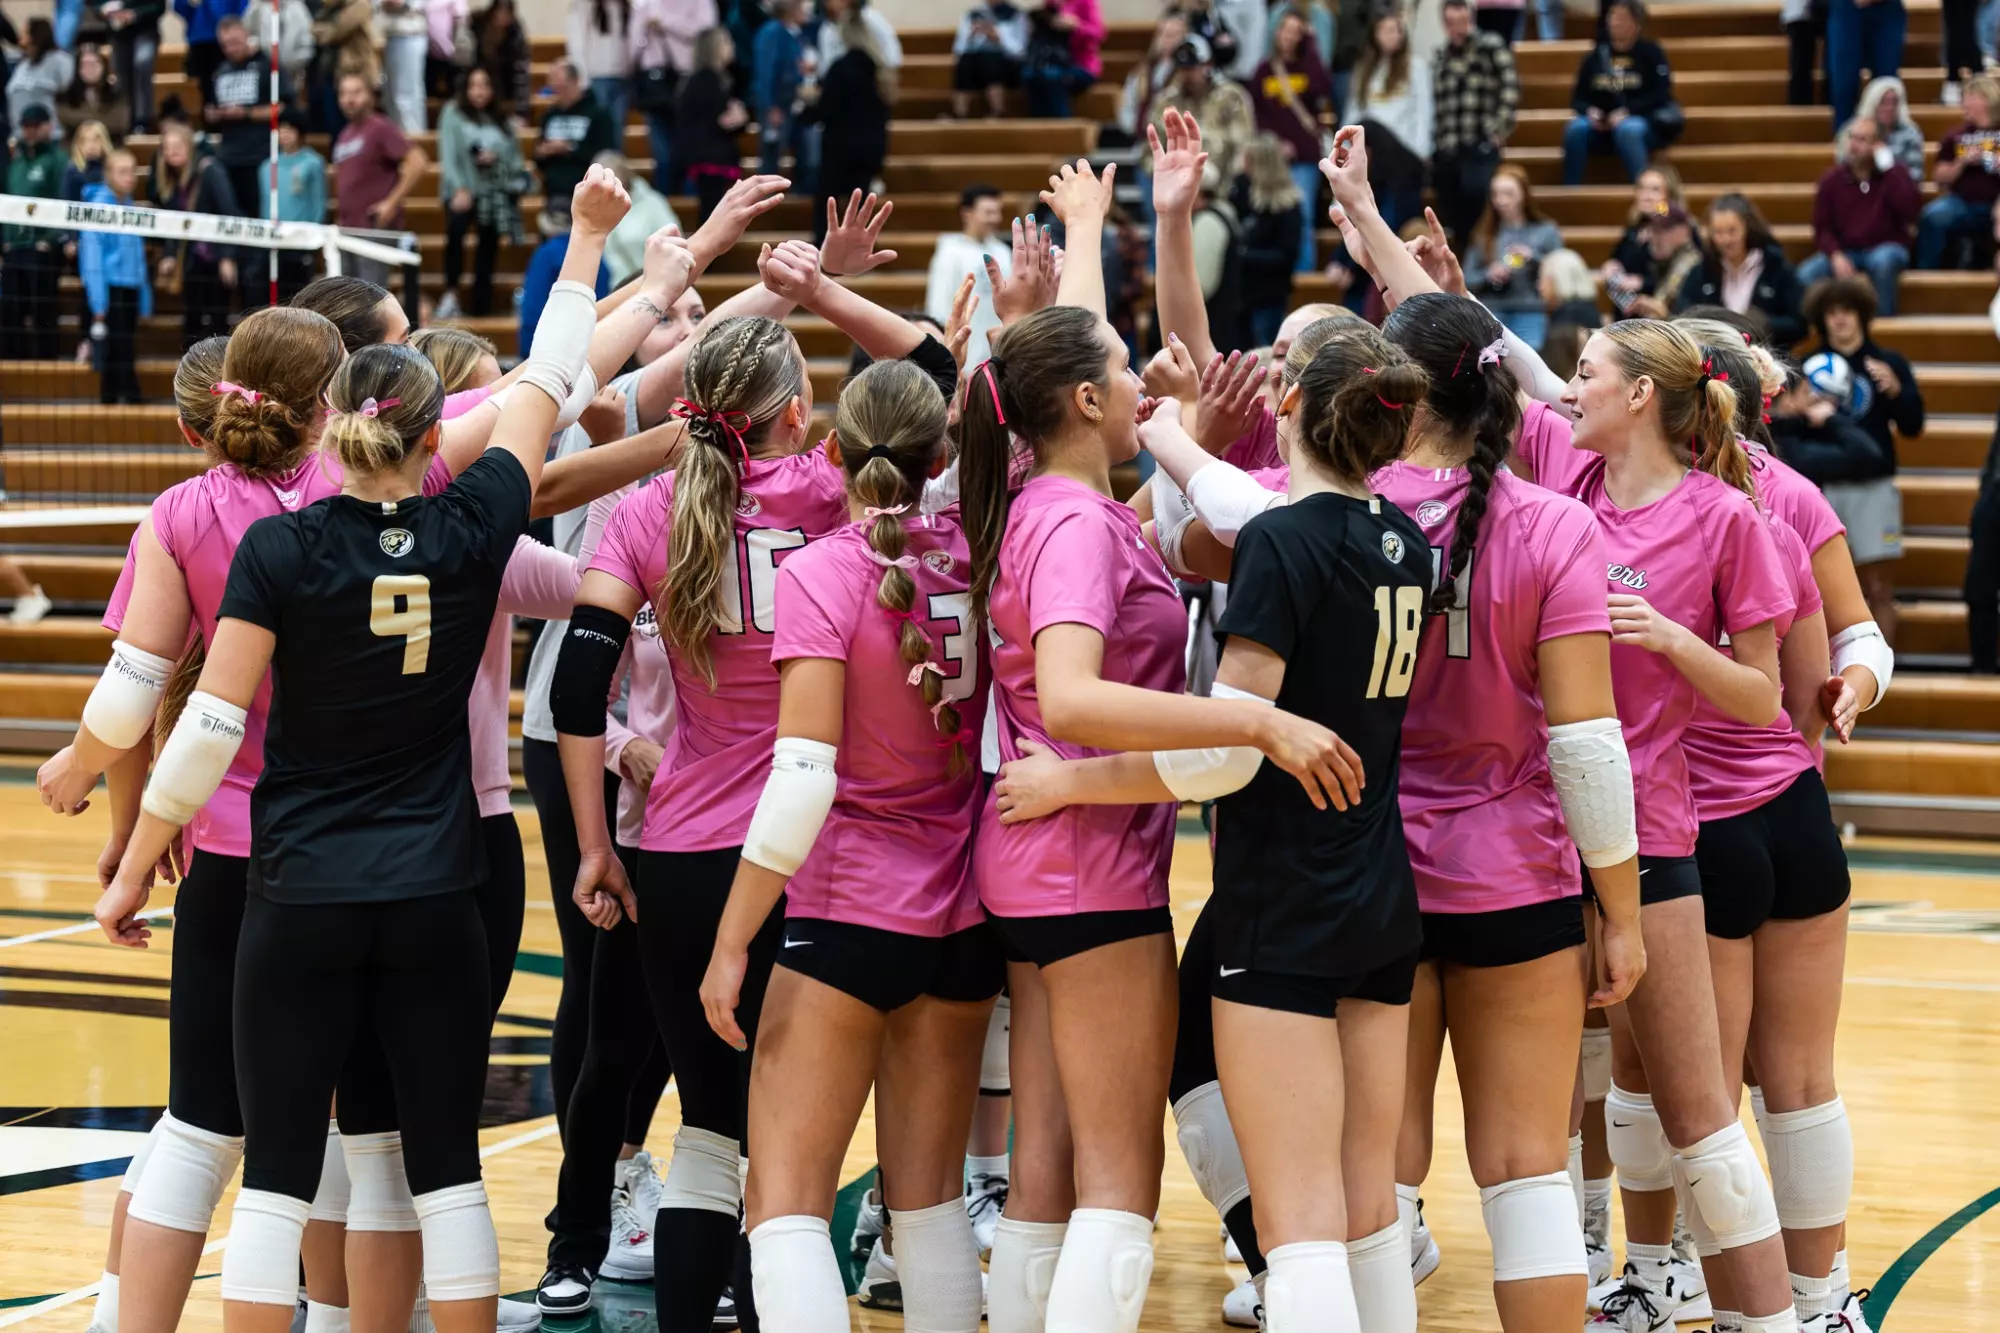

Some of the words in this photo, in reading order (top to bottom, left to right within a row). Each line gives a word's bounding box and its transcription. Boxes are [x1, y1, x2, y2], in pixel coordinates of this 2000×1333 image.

[370, 574, 432, 675] 9
[927, 590, 981, 702] 3
[1365, 586, 1424, 699] 18
